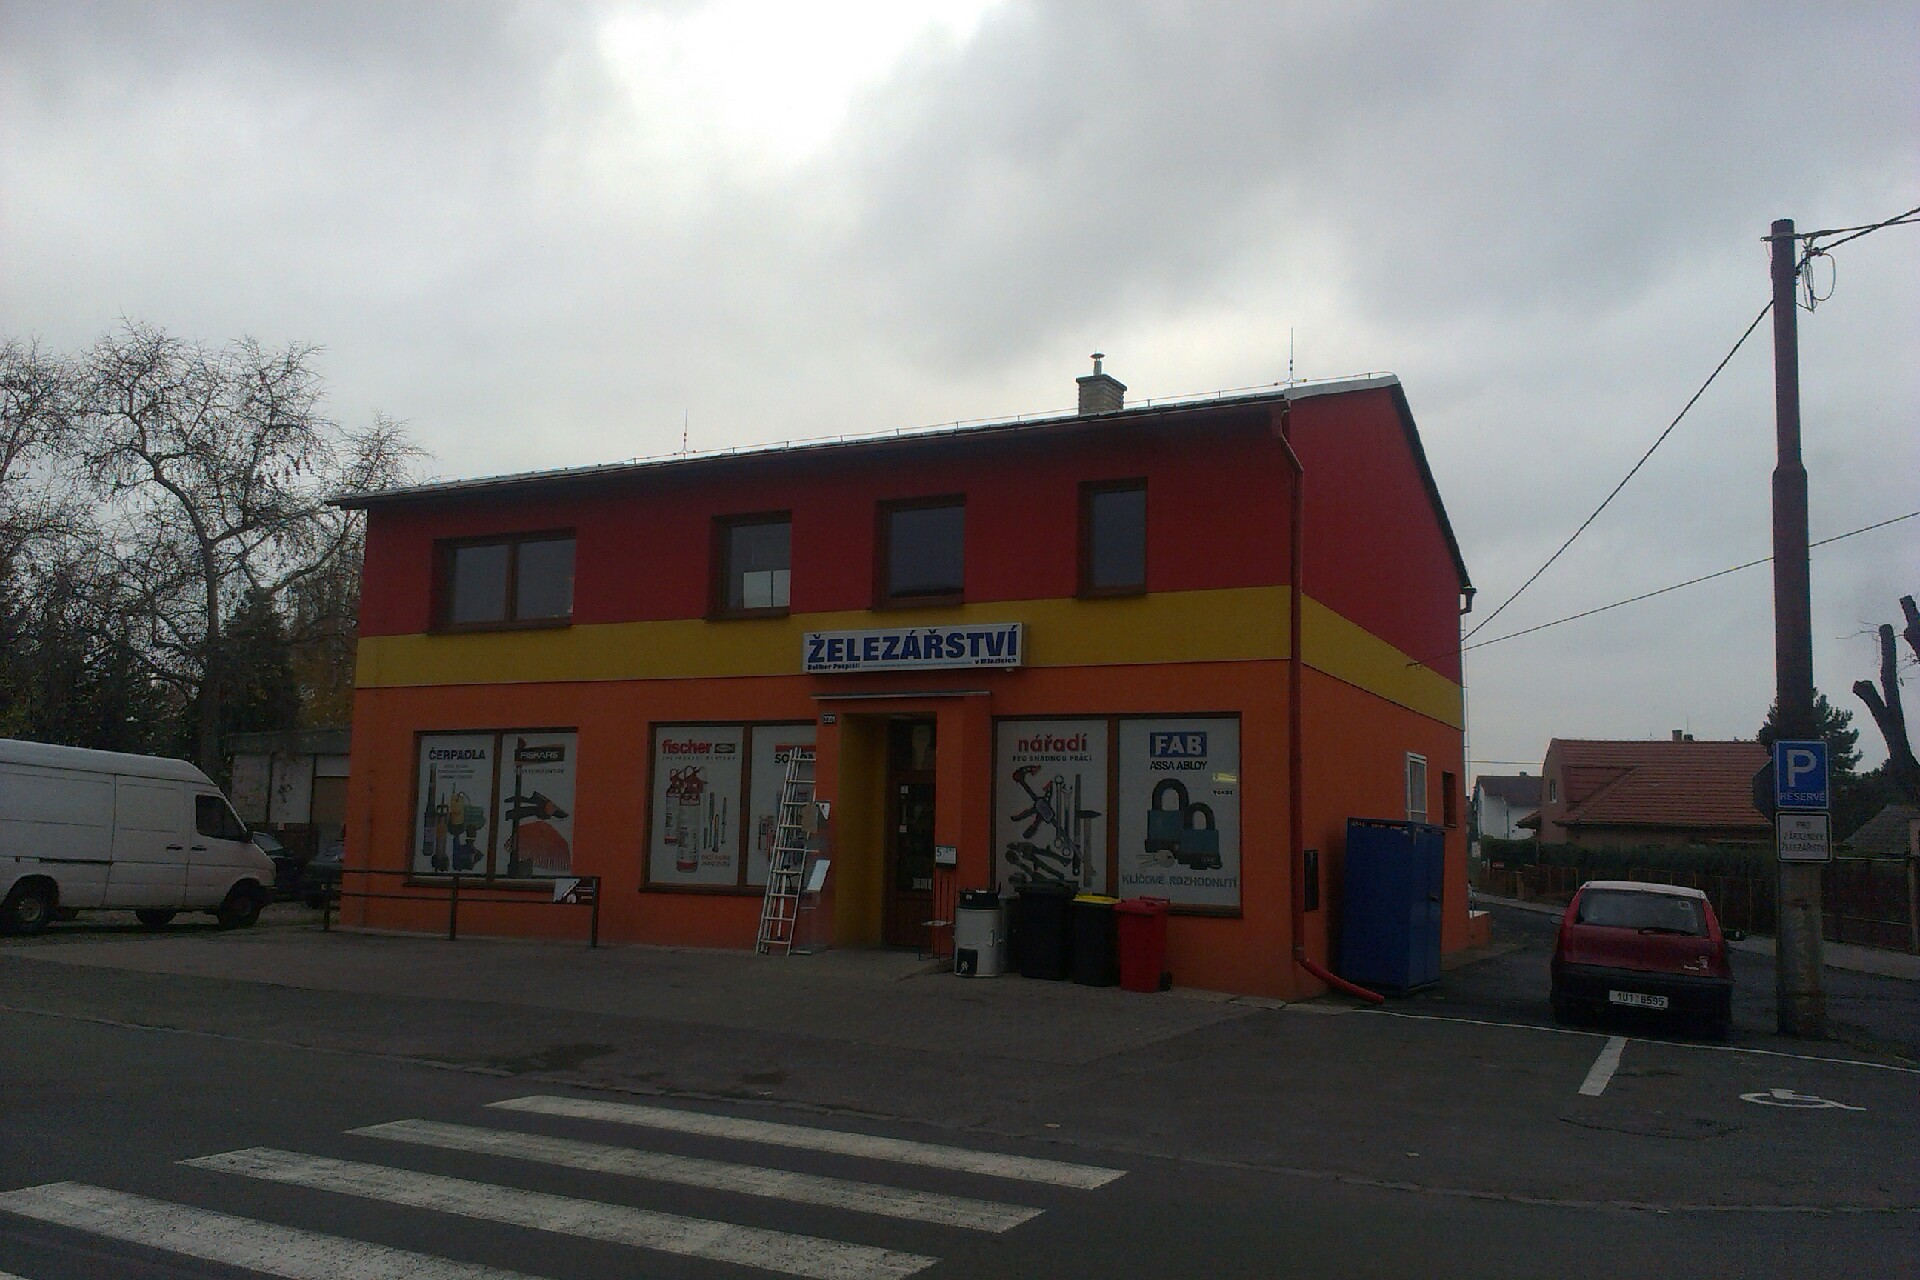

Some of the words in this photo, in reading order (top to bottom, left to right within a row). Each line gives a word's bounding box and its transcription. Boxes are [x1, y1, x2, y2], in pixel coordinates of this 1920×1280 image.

[808, 624, 1018, 663] ŽELEZÁŘSTVÍ
[662, 738, 713, 754] fischer
[1018, 732, 1088, 752] nářadí
[1155, 735, 1203, 755] FAB
[428, 746, 486, 760] ČERPADLA
[520, 751, 559, 760] FISKARS
[1069, 753, 1093, 762] PRÁCI
[1150, 760, 1175, 771] ASSA
[1175, 760, 1208, 771] ABLOY
[1787, 749, 1818, 788] P
[1121, 872, 1165, 885] KLÍČOVÉ
[1168, 874, 1237, 889] ROZHODNUTÍ
